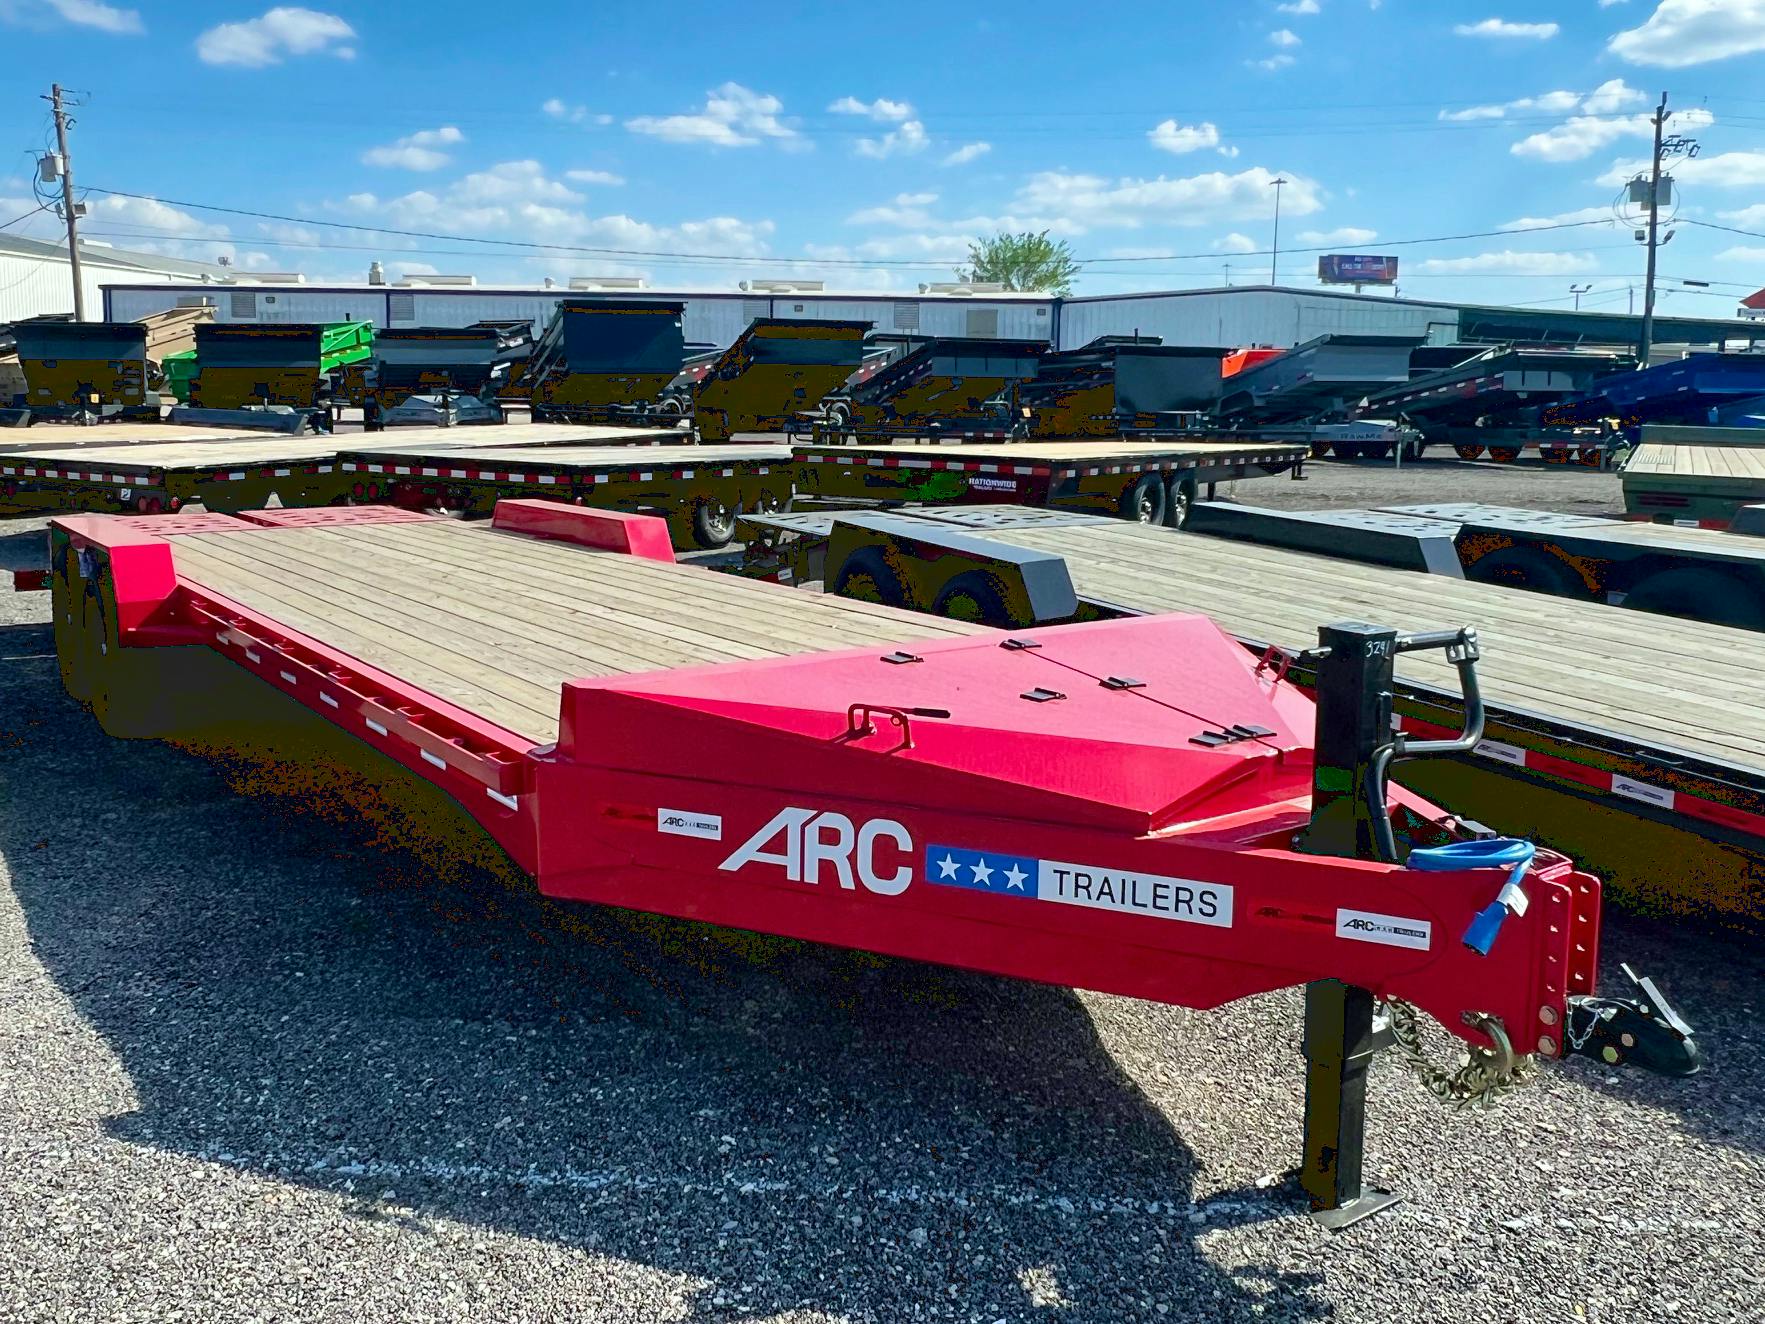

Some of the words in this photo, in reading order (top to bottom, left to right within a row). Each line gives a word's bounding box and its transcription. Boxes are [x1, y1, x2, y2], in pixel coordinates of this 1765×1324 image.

[662, 816, 684, 827] ARC
[718, 807, 913, 896] ARC
[1053, 869, 1219, 918] TRAILERS
[1343, 918, 1375, 932] ARC
